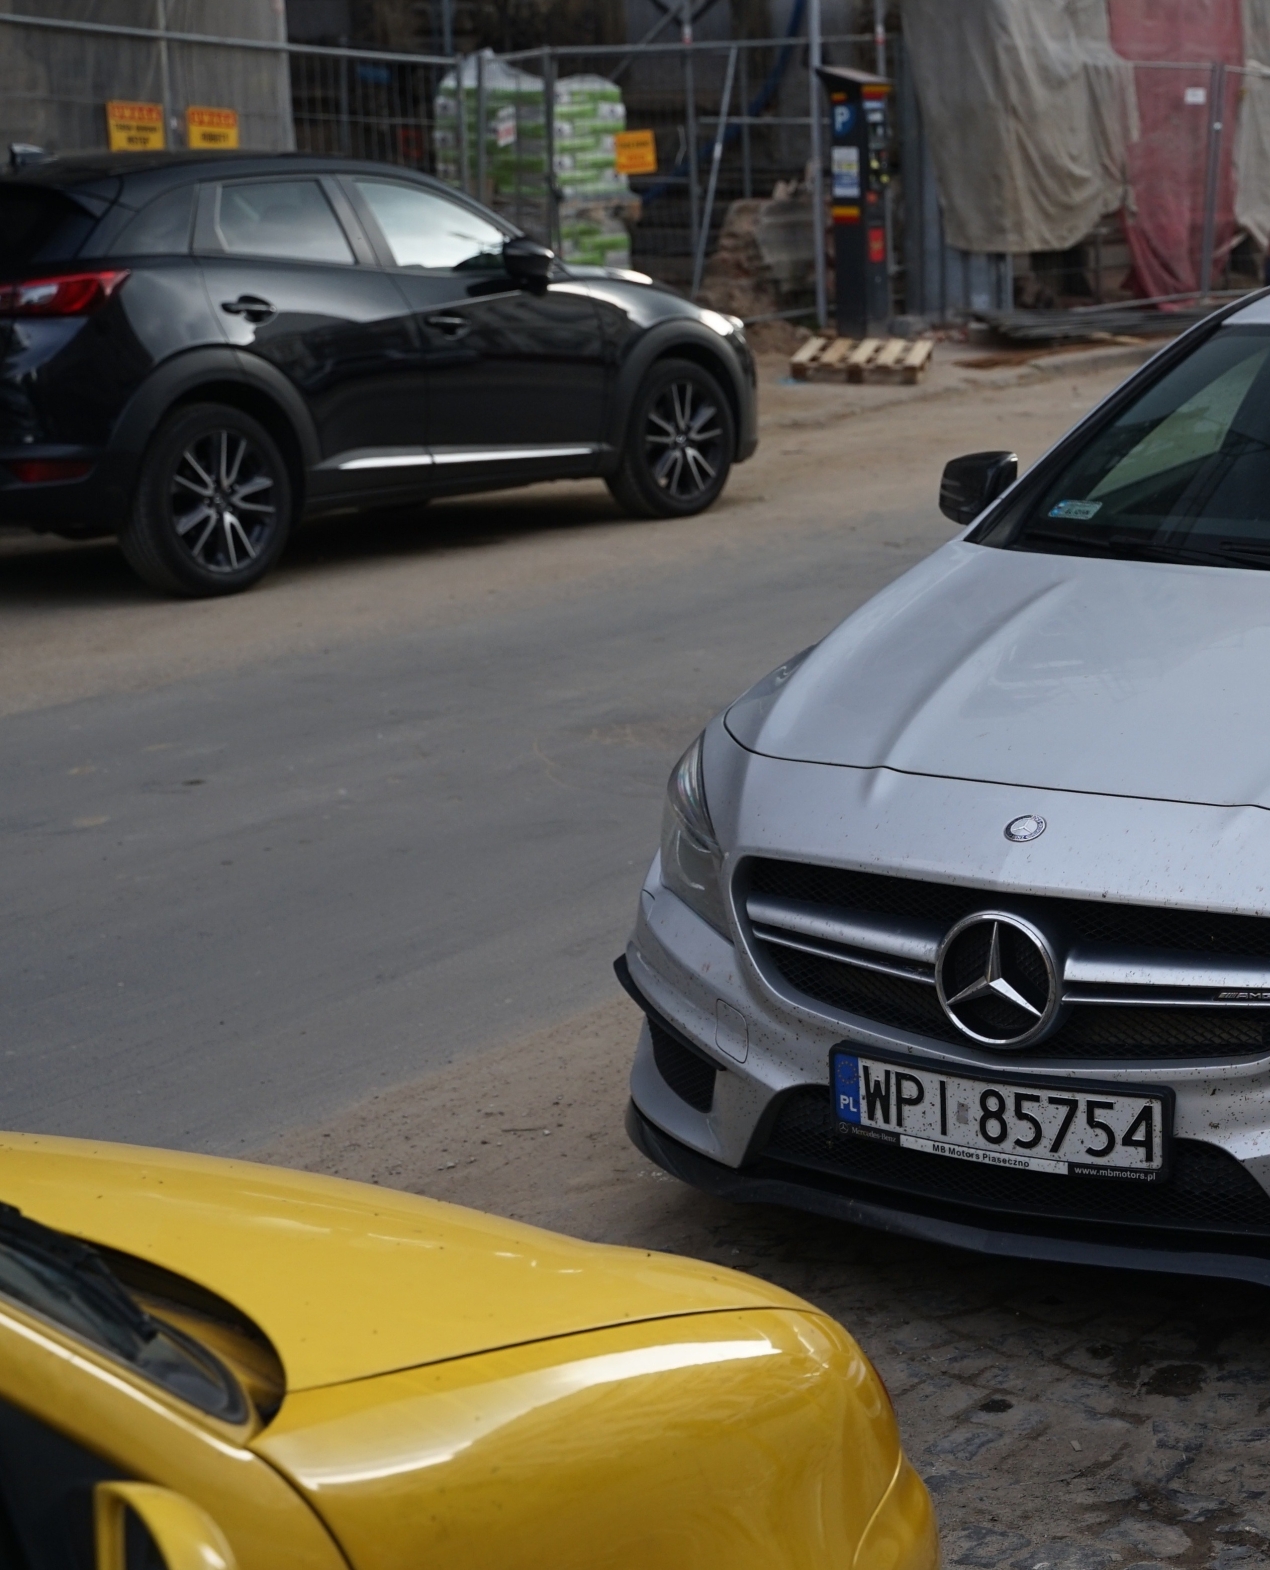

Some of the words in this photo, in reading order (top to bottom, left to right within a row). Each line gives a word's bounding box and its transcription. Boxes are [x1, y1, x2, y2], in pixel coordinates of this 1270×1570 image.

[834, 105, 851, 133] P
[839, 1095, 858, 1113] PL
[862, 1065, 948, 1136] WPI
[979, 1088, 1155, 1163] 85754
[851, 1126, 897, 1143] Mercedes-Benz
[932, 1143, 947, 1155] MB
[948, 1147, 980, 1161] Motors
[982, 1150, 1030, 1169] Piaseczno
[1074, 1166, 1157, 1182] www.mbmotors.pl
